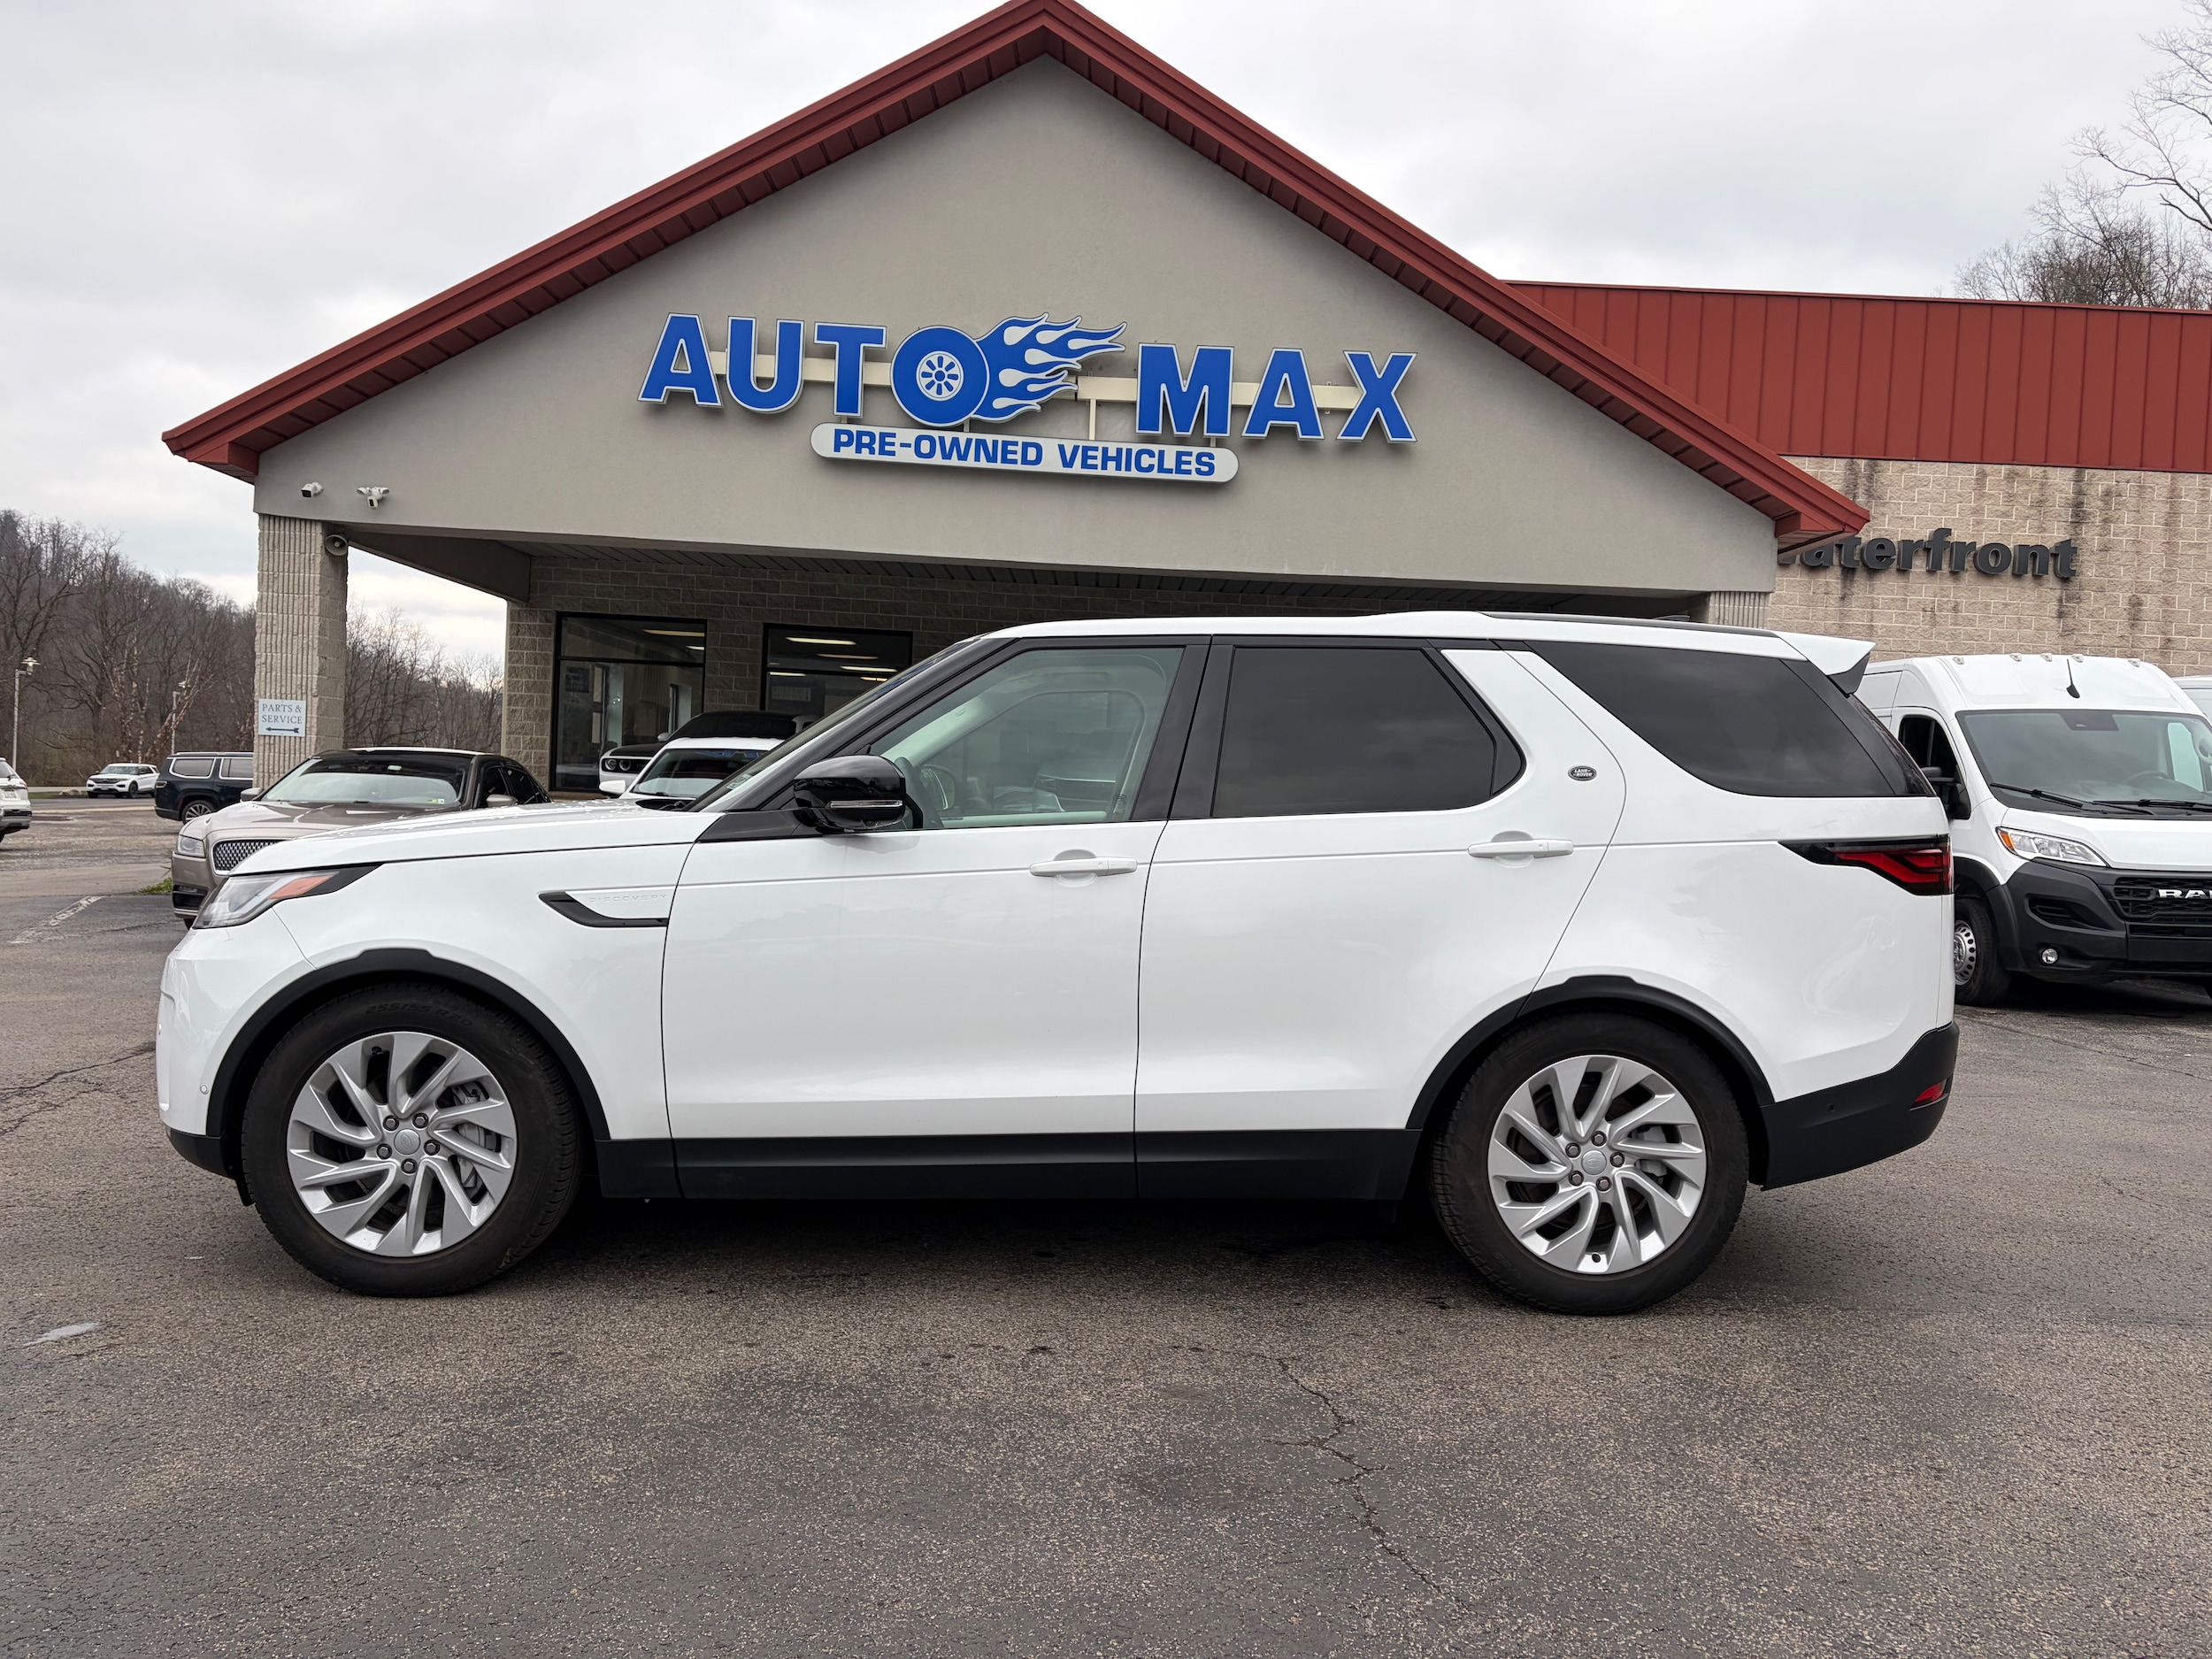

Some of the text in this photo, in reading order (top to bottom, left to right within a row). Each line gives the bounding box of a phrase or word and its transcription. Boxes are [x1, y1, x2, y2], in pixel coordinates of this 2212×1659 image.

[639, 312, 1417, 442] AUTO MAX
[833, 429, 1216, 477] PRE-OWNED VEHICLES
[1778, 527, 2078, 579] aterfront
[262, 703, 303, 713] PARTS &
[261, 714, 303, 725] SERVICE
[588, 894, 667, 903] DISCOVERY
[2159, 888, 2212, 900] RA
